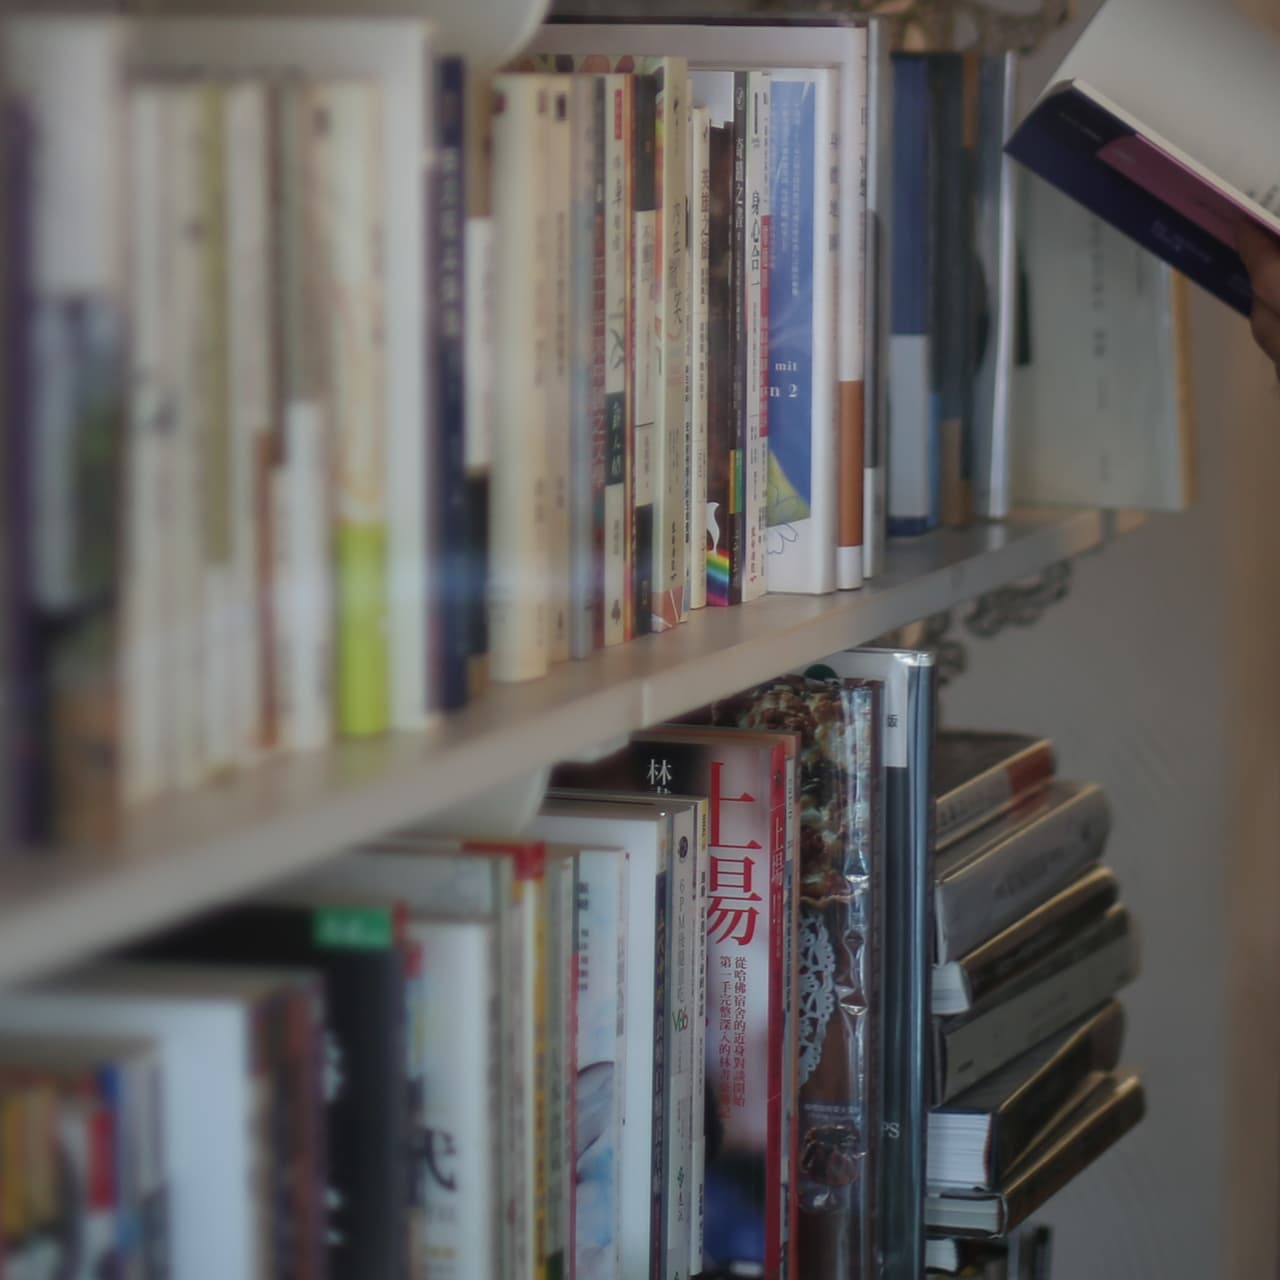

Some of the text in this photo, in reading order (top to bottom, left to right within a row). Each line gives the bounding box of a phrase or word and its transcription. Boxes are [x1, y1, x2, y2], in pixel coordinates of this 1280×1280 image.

[775, 360, 798, 371] mit
[788, 383, 799, 398] 2
[646, 758, 672, 793] 林
